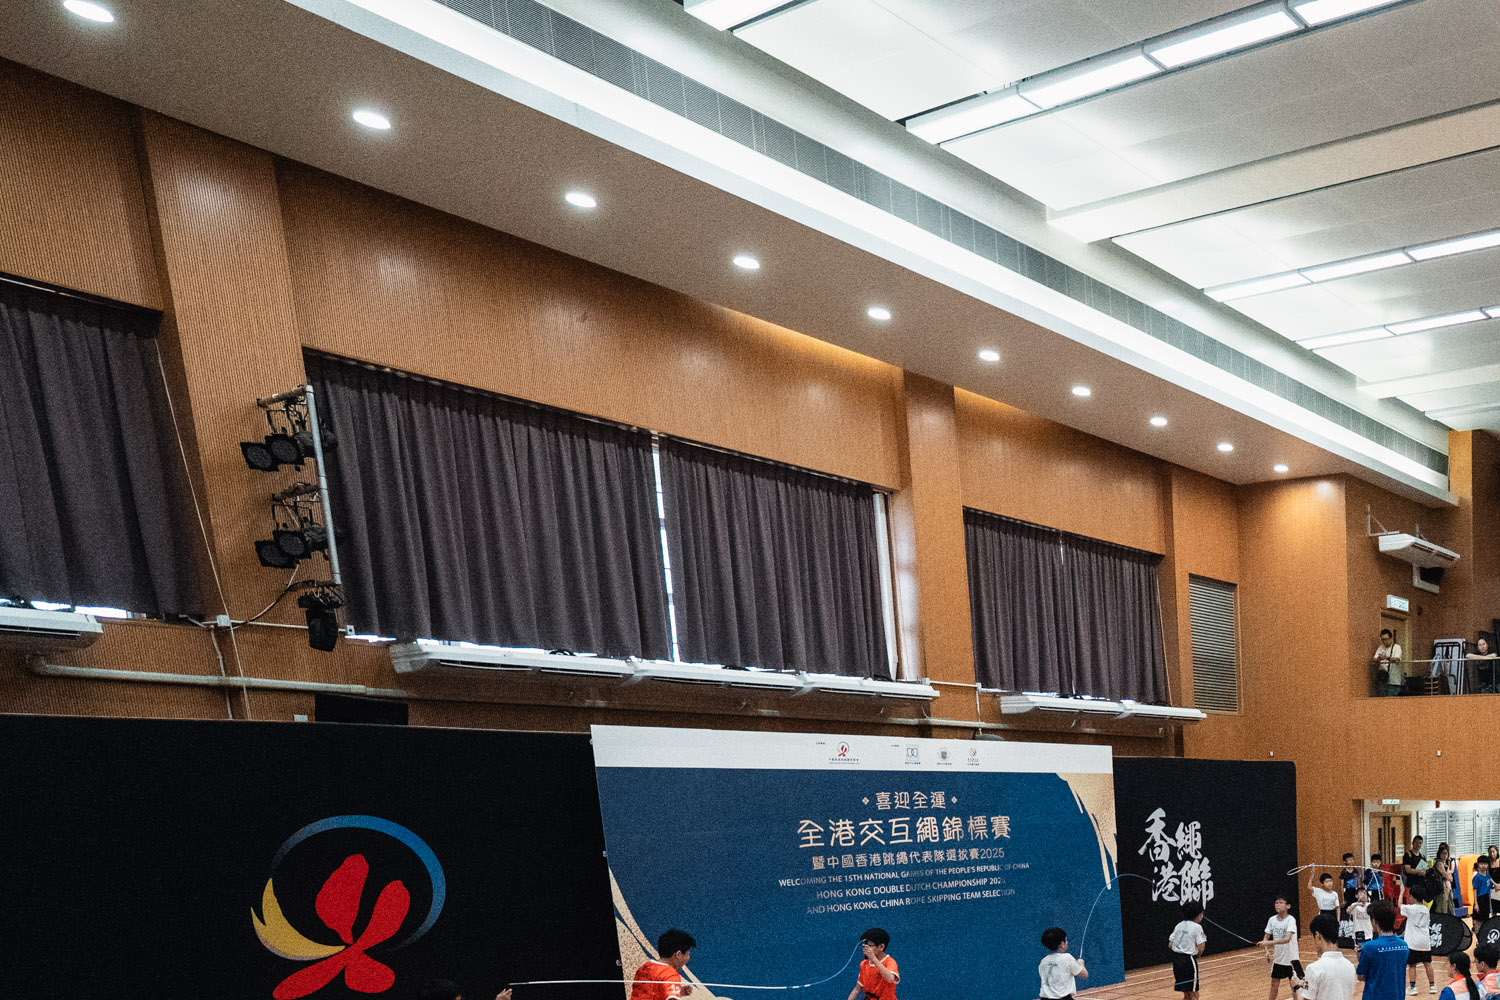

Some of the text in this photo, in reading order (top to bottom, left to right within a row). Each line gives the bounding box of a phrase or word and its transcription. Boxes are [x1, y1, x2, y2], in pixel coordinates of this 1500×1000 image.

[875, 791, 946, 810] 喜迎全運
[797, 815, 1011, 848] 全港交互繩錦標賽
[778, 877, 827, 887] WELCOMING
[828, 875, 842, 883] THE
[844, 874, 862, 882] 15TH
[864, 871, 900, 880] NATIONAL
[901, 869, 924, 878] GAMES
[948, 866, 975, 874] PEOPLE'S
[976, 864, 1003, 872] REPUBLIC
[1012, 862, 1030, 870] CHINA
[816, 889, 843, 899] HONG
[845, 887, 871, 897] KONG
[873, 884, 905, 894] DOUBLE
[905, 882, 931, 891] DUTCH
[932, 878, 988, 889] CHAMPIONSHIP
[807, 889, 1016, 914] AND HONG KONG, CHINA ROPE SKIPPING TEAM SELECTION
